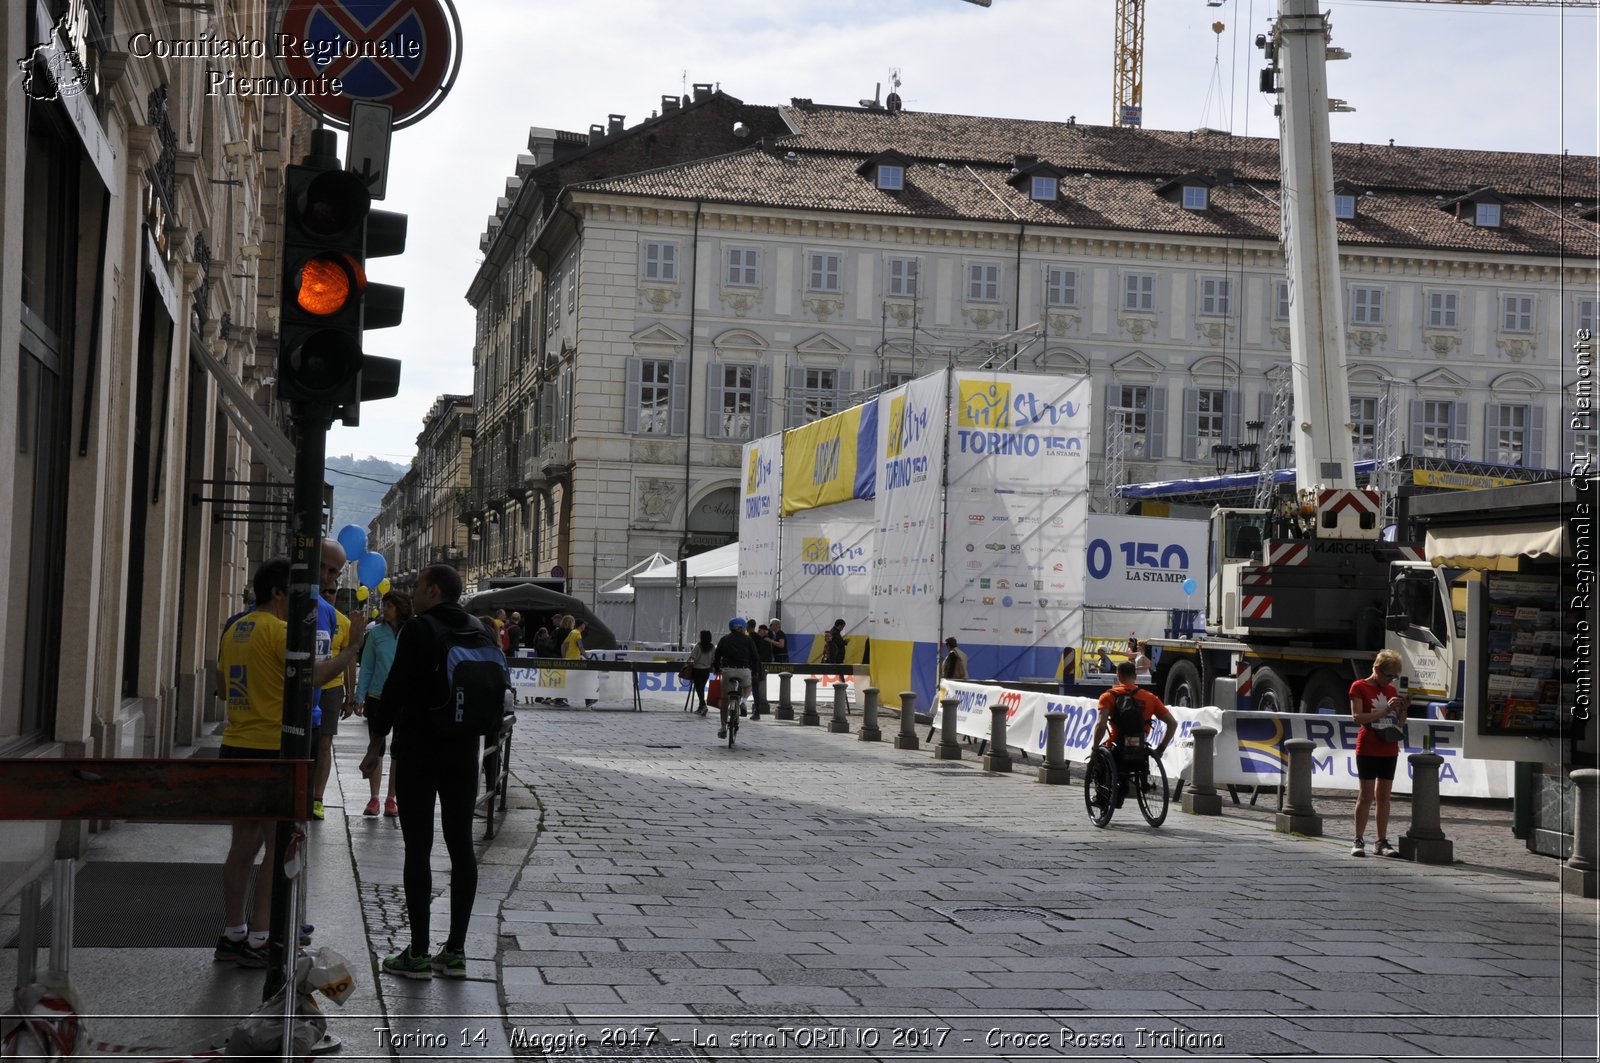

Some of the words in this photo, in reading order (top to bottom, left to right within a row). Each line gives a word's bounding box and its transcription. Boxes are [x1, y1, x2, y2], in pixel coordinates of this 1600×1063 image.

[967, 405, 990, 425] 41
[1013, 392, 1081, 427] Stra
[958, 430, 1040, 457] TORINO
[1043, 436, 1082, 450] 150
[885, 456, 912, 491] TORINO
[830, 542, 864, 560] Stra
[1119, 541, 1189, 570] 150
[802, 563, 845, 576] TORINO
[1126, 571, 1141, 581] LA
[1142, 572, 1188, 584] STAMPA
[552, 661, 588, 670] MARATHON
[1304, 719, 1456, 756] RELE
